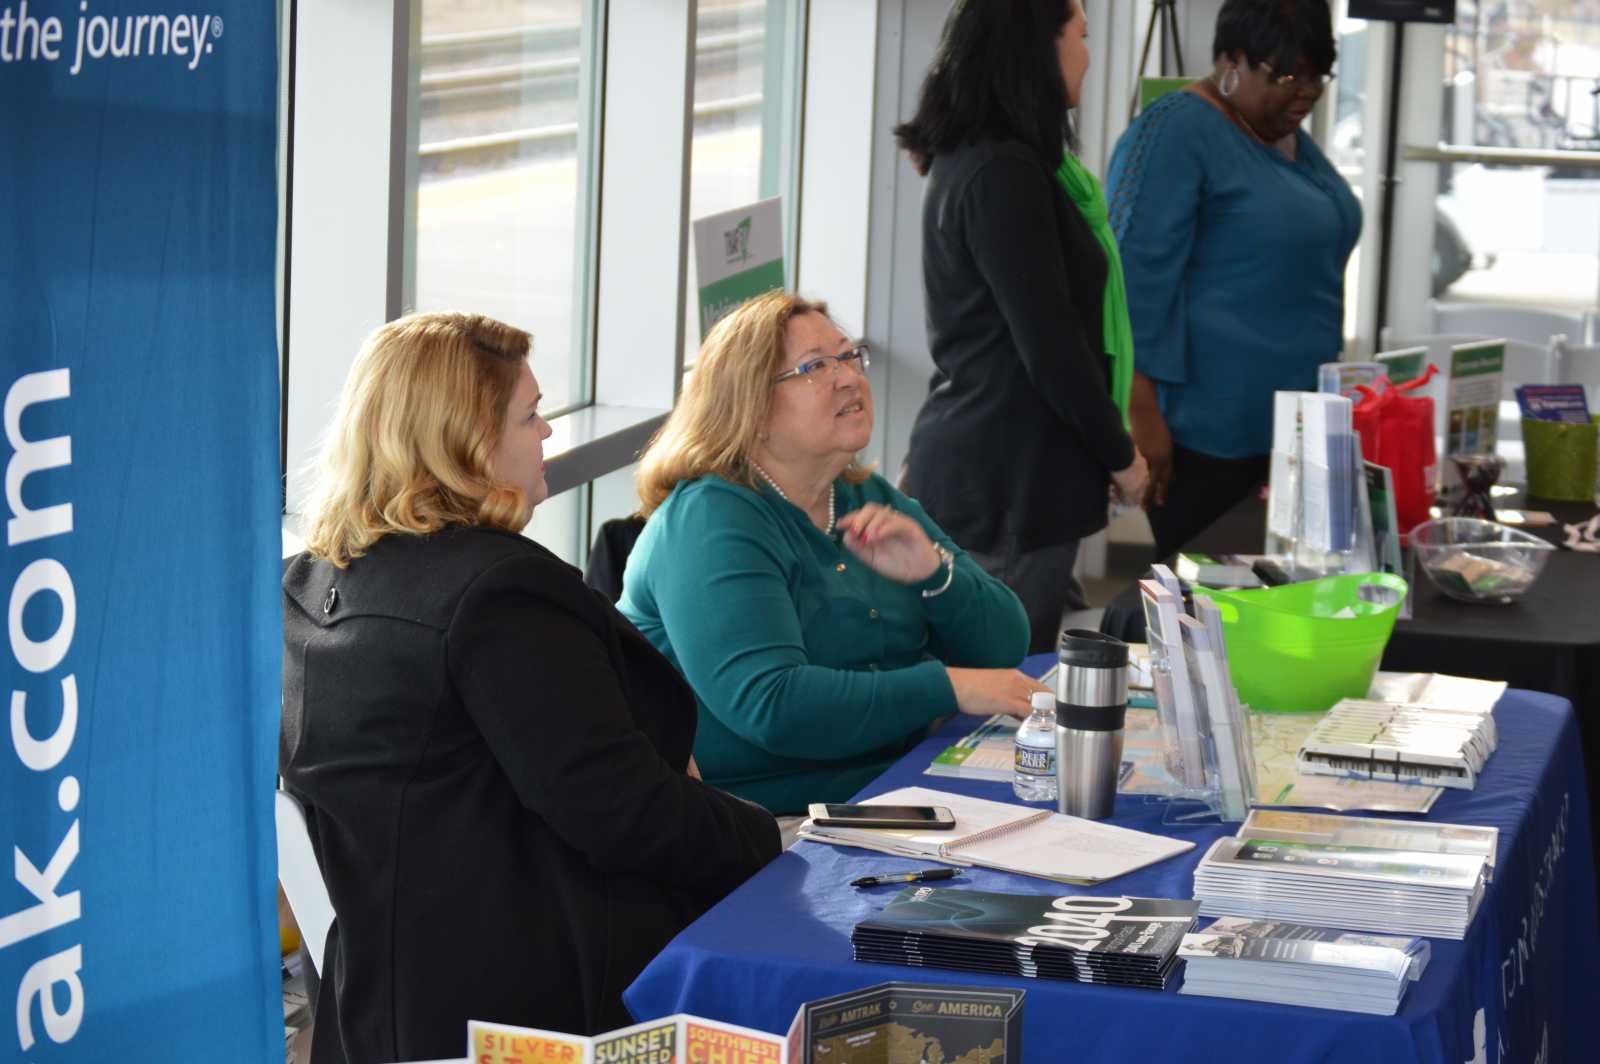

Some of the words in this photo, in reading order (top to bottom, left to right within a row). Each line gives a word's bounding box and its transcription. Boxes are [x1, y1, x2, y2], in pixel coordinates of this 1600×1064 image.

[0, 0, 63, 62] the
[1021, 758, 1049, 769] PARK
[1022, 751, 1046, 761] DEER
[1014, 895, 1133, 951] 2040
[938, 1001, 1003, 1018] AMERICA
[484, 1033, 575, 1062] SILVER
[595, 1025, 674, 1064] SUNSET
[688, 1026, 779, 1057] SOUTHWEST
